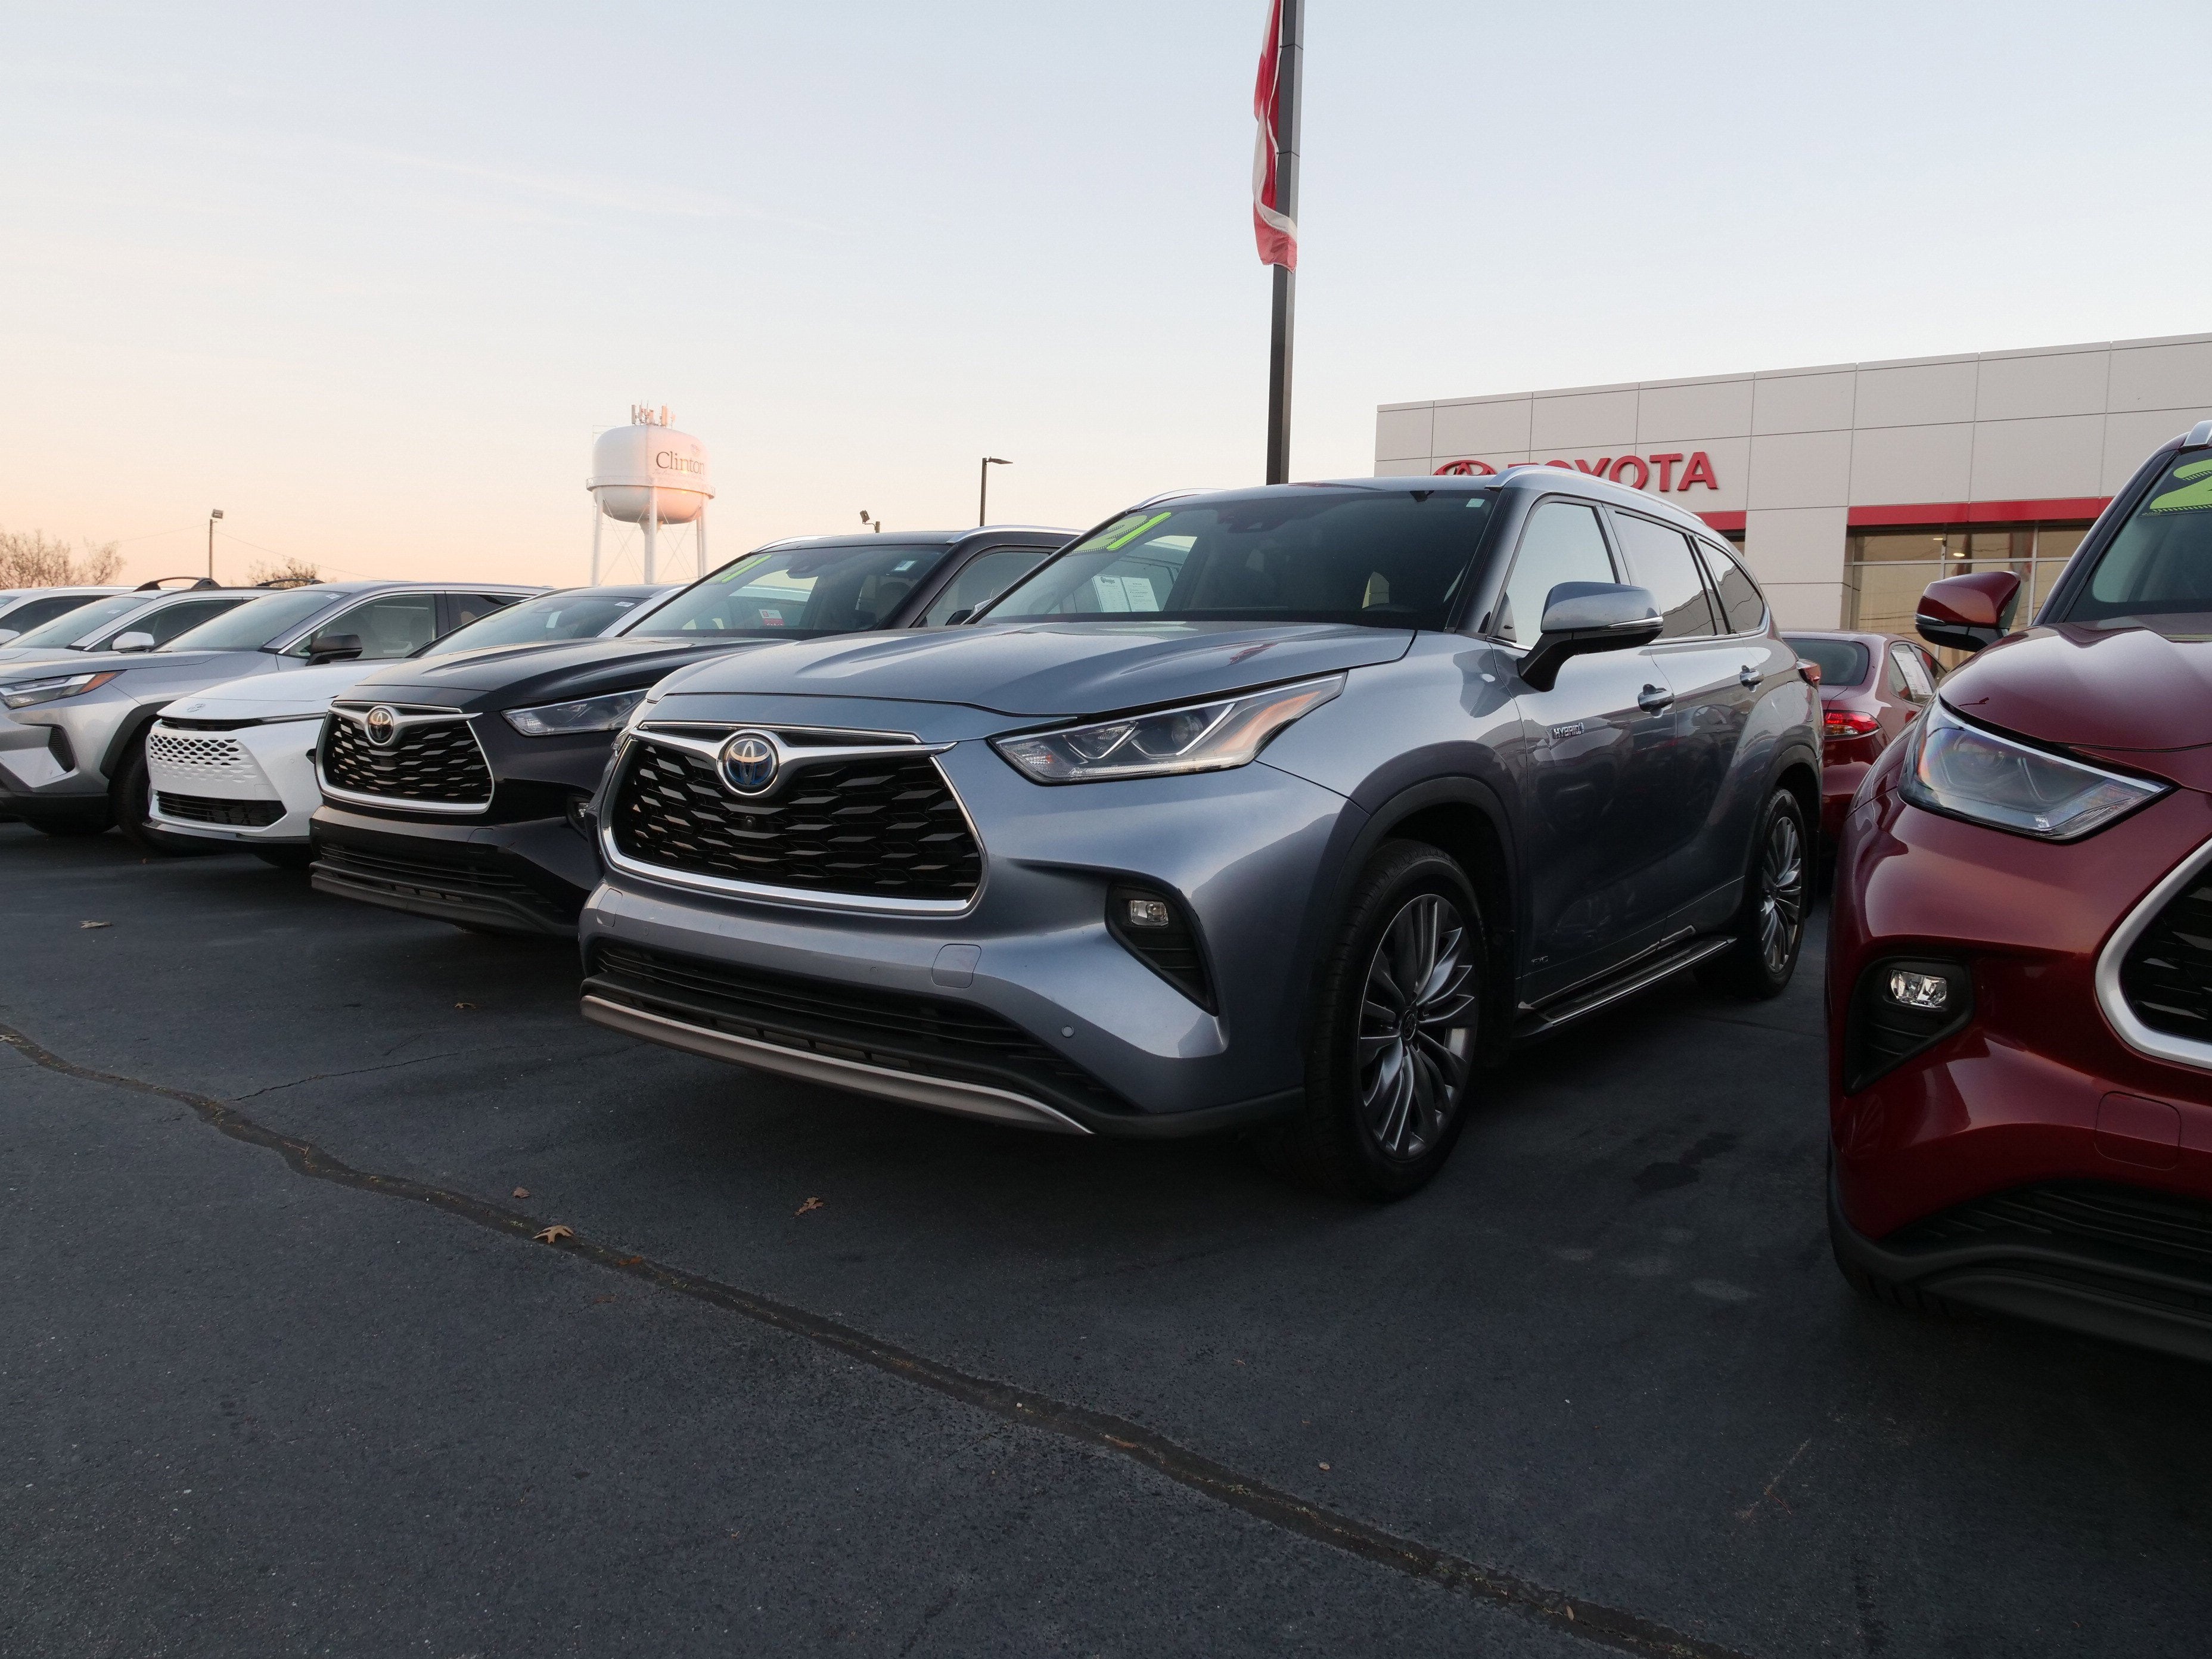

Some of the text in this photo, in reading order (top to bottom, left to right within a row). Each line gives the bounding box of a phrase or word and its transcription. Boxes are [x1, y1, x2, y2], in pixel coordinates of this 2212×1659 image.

[656, 451, 705, 475] Clinton
[1508, 451, 1719, 492] YOTA
[1071, 512, 1172, 554] 21
[1553, 725, 1580, 738] HYBRID
